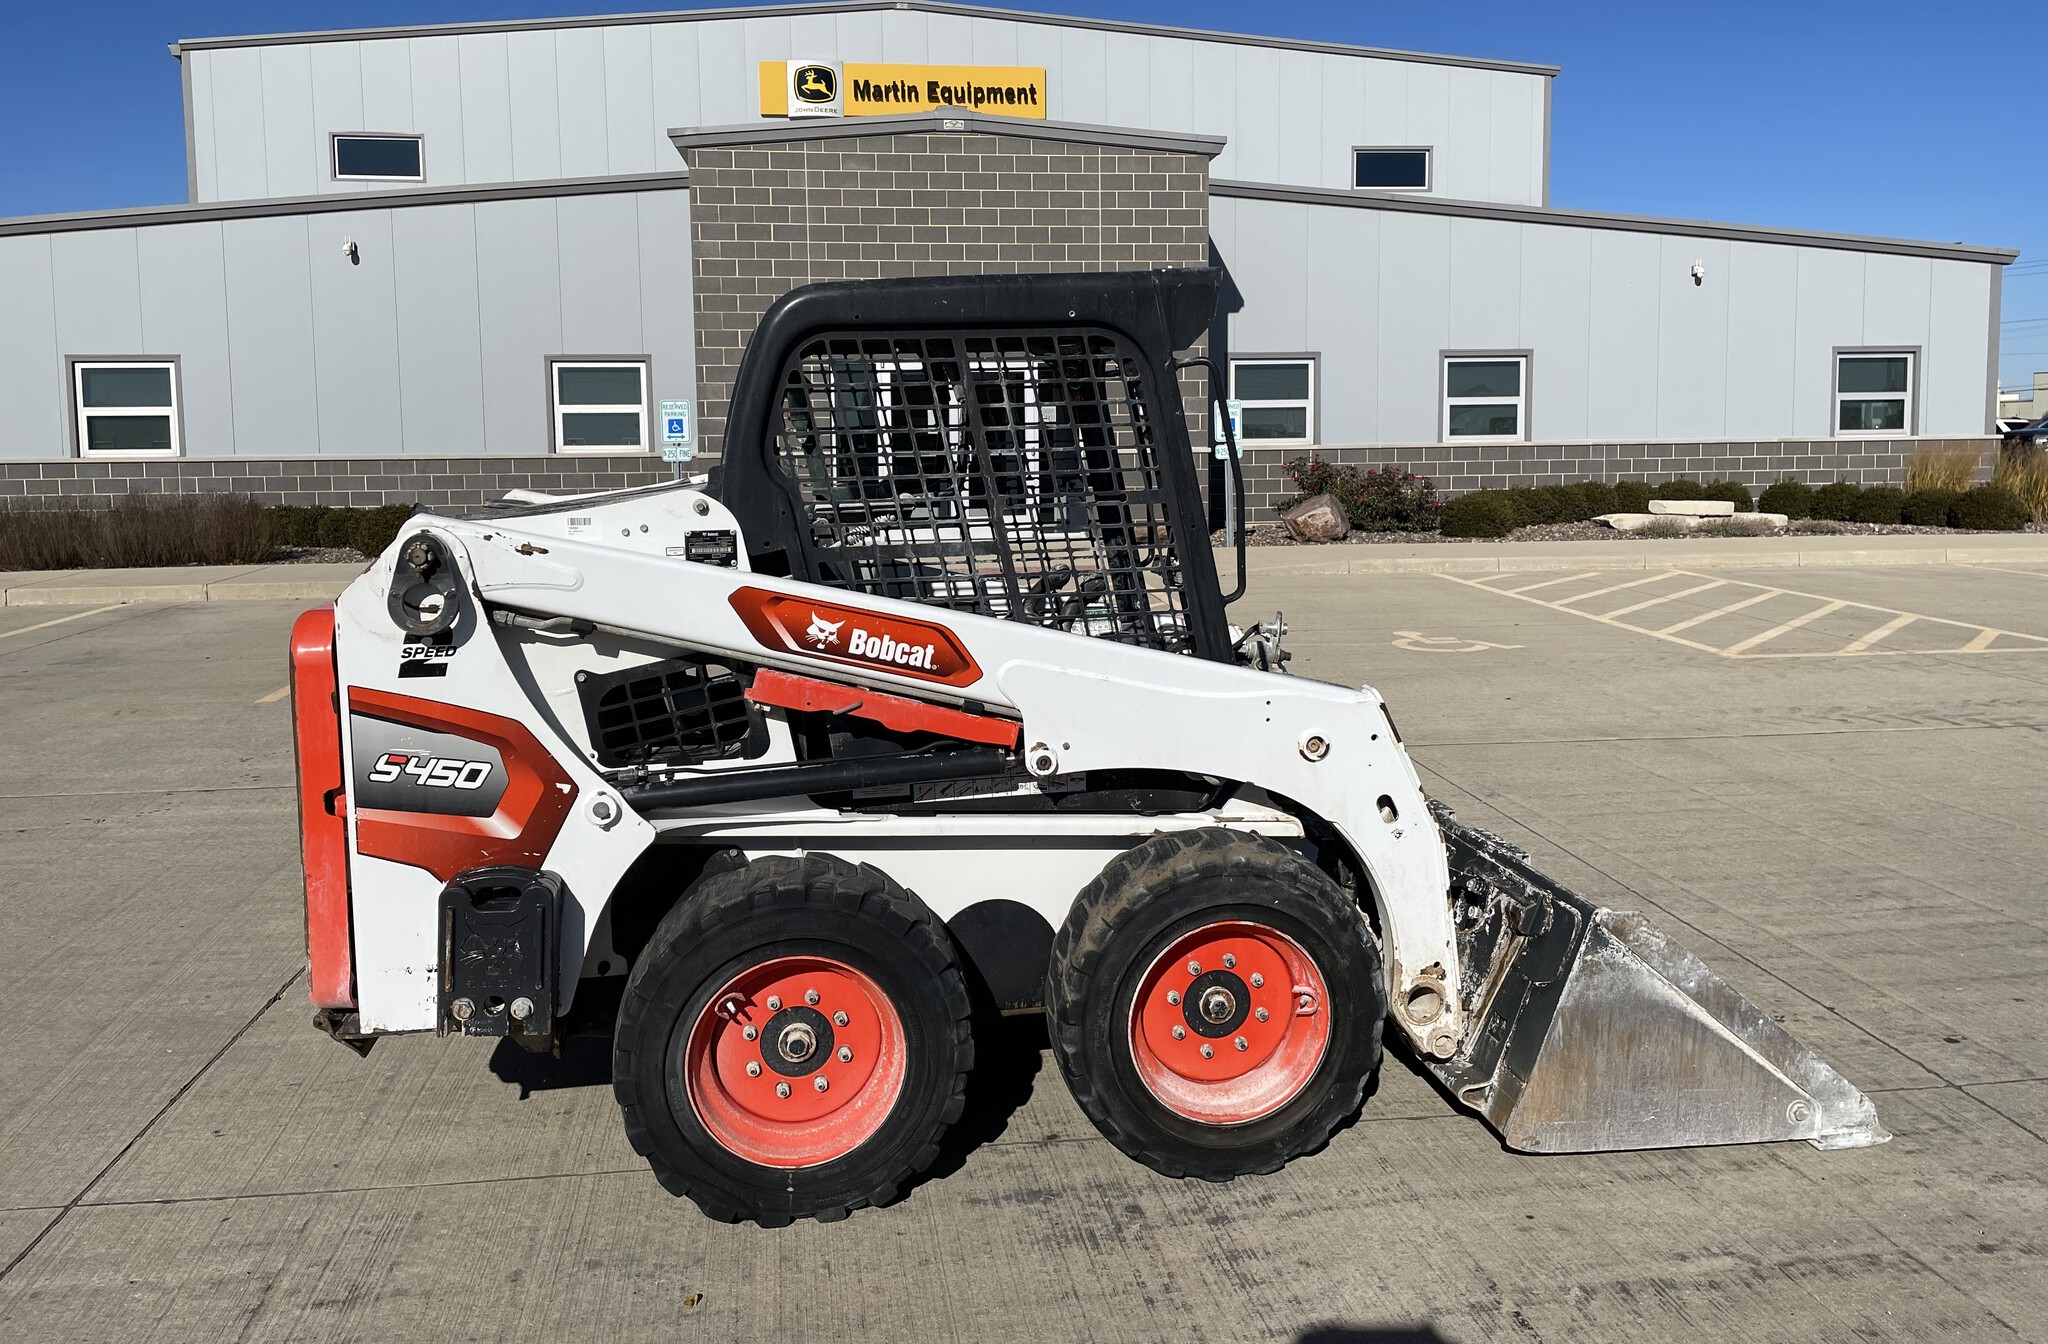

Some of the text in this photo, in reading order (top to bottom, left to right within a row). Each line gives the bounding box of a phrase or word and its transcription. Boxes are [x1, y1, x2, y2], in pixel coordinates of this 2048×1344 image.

[853, 79, 1038, 108] Martin Equipment
[400, 645, 458, 659] SPEED
[847, 627, 936, 670] Bobcat
[367, 752, 494, 790] S450
